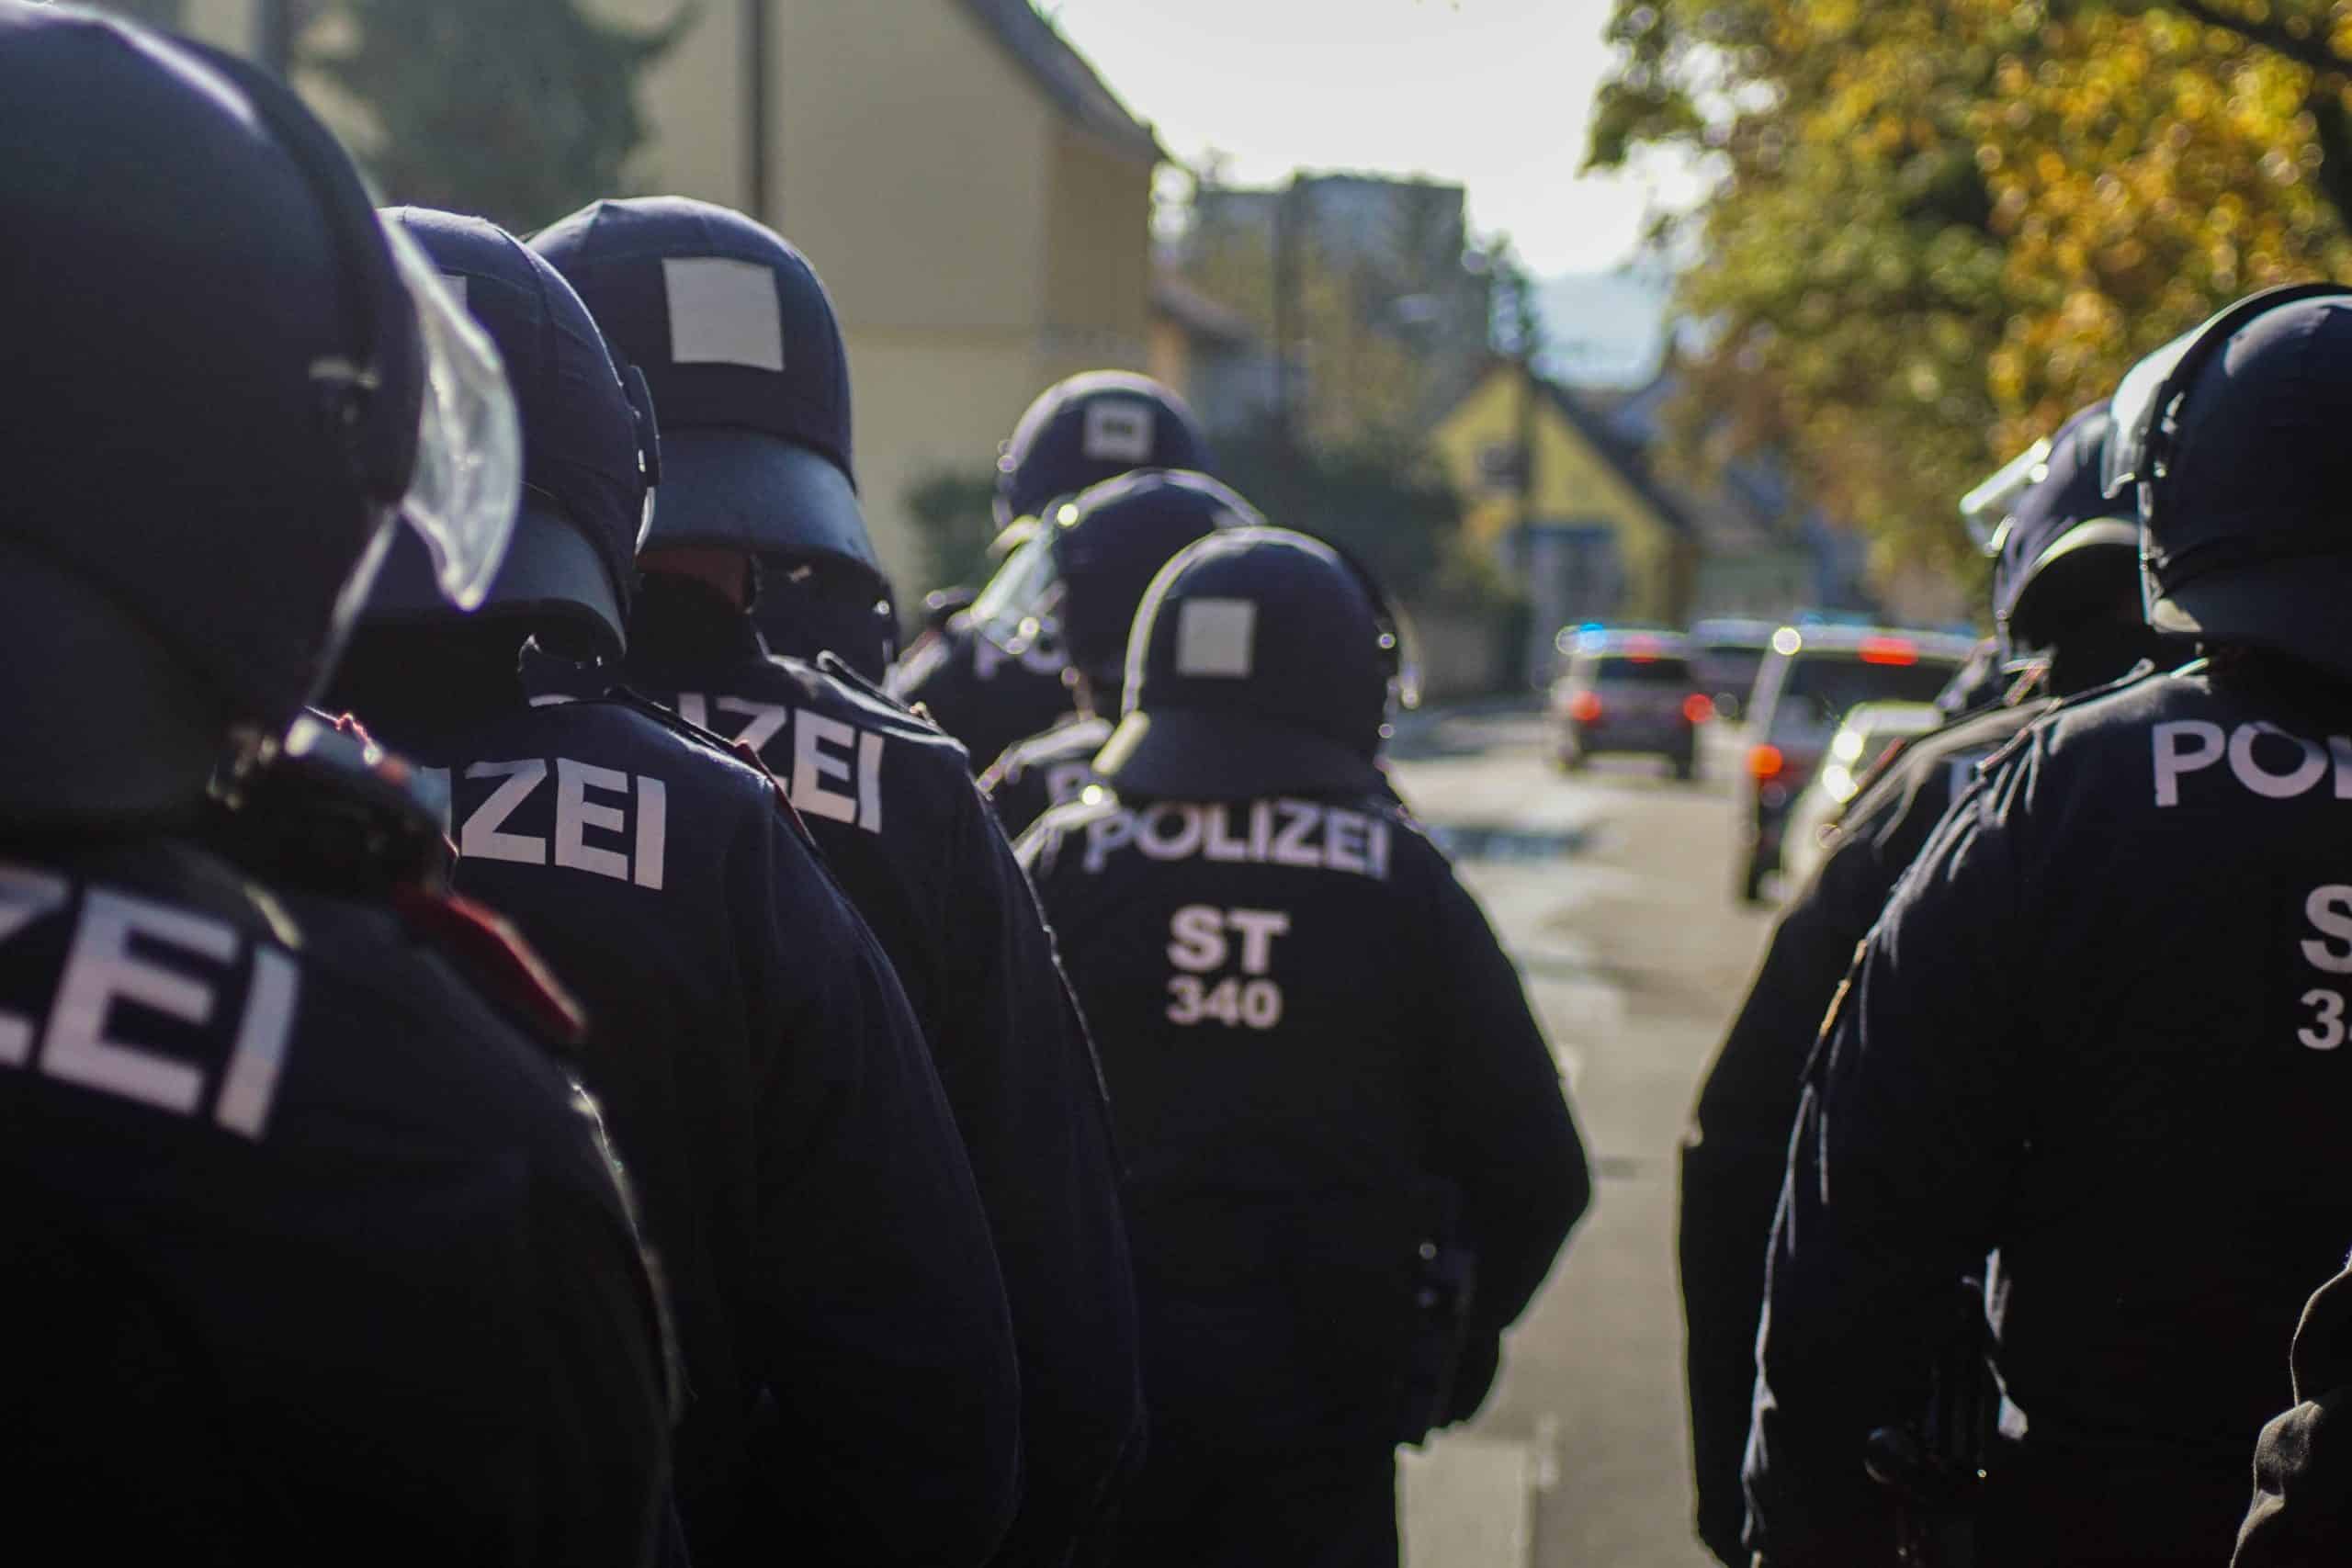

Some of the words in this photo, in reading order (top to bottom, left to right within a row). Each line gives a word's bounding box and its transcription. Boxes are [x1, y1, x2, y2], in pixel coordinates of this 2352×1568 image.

[1083, 798, 1390, 879] POLIZEI
[1167, 904, 1290, 974] ST
[1167, 976, 1282, 1029] 340
